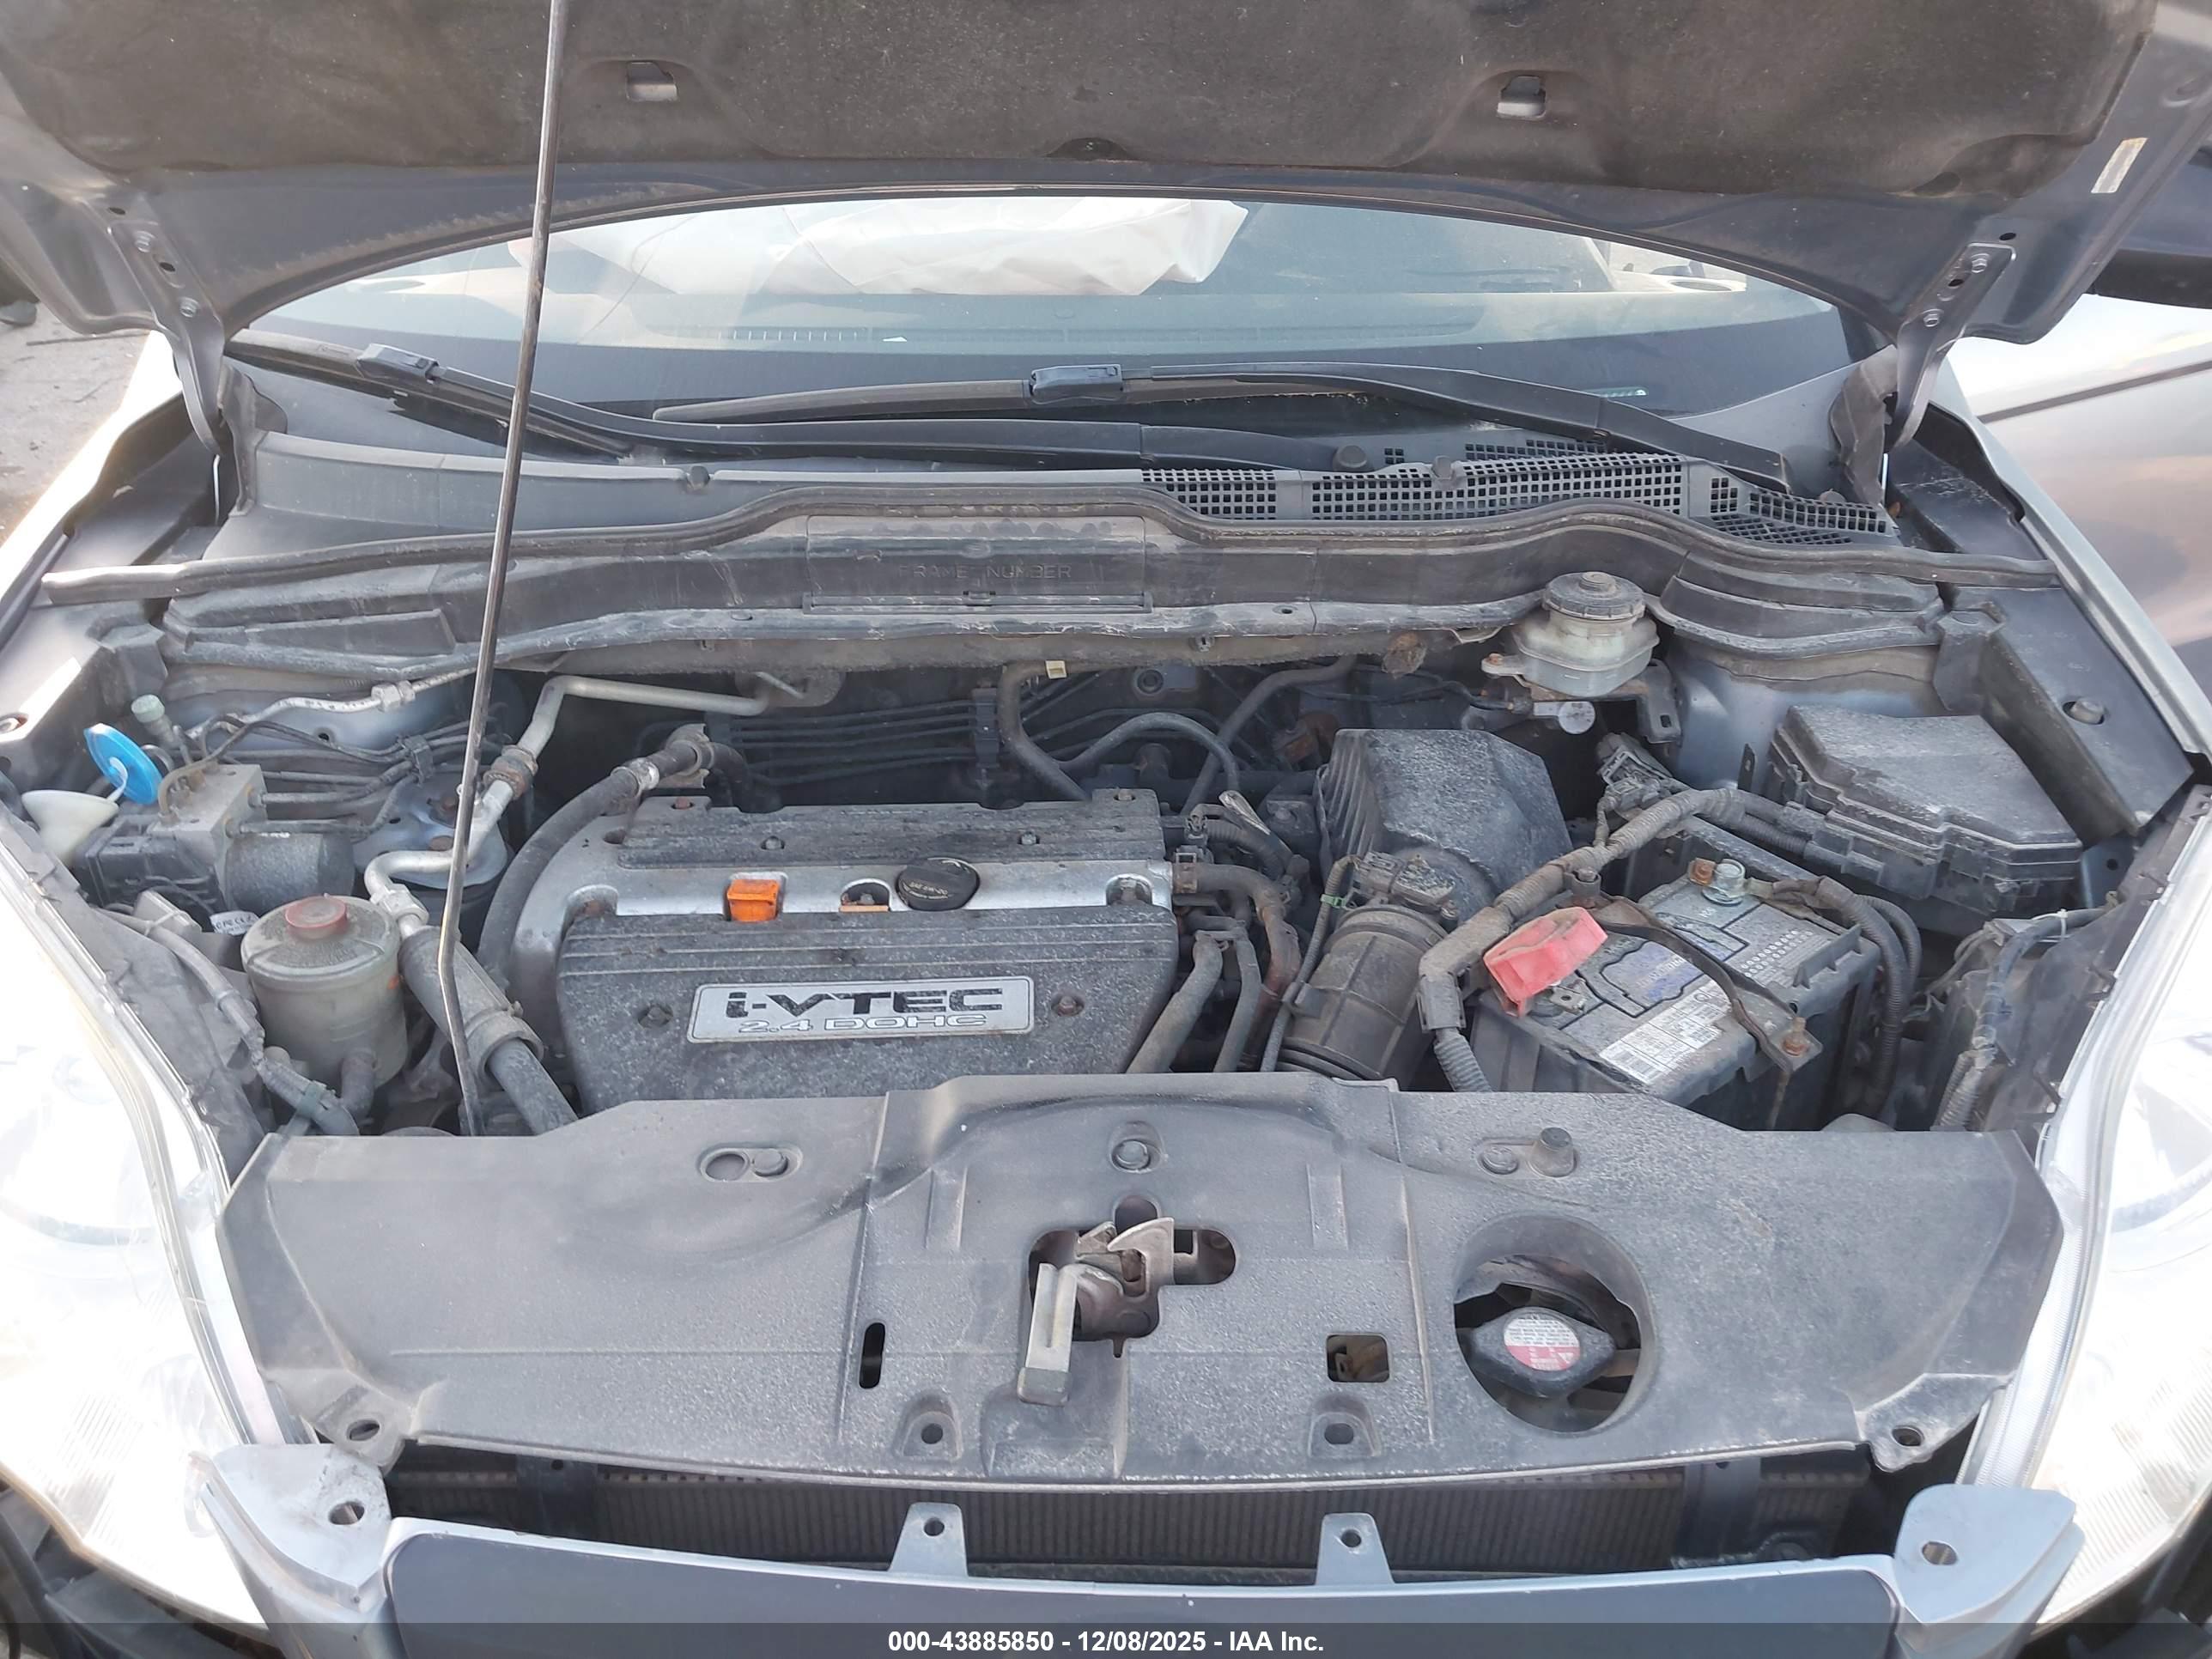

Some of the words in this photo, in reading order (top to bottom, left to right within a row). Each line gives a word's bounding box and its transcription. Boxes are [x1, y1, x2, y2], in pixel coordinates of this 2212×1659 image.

[899, 565, 969, 579] FRAME
[987, 565, 1073, 579] NUMBER
[726, 988, 1002, 1018] i-VTEC
[738, 1018, 813, 1033] 2.4
[823, 1013, 988, 1031] DOHC
